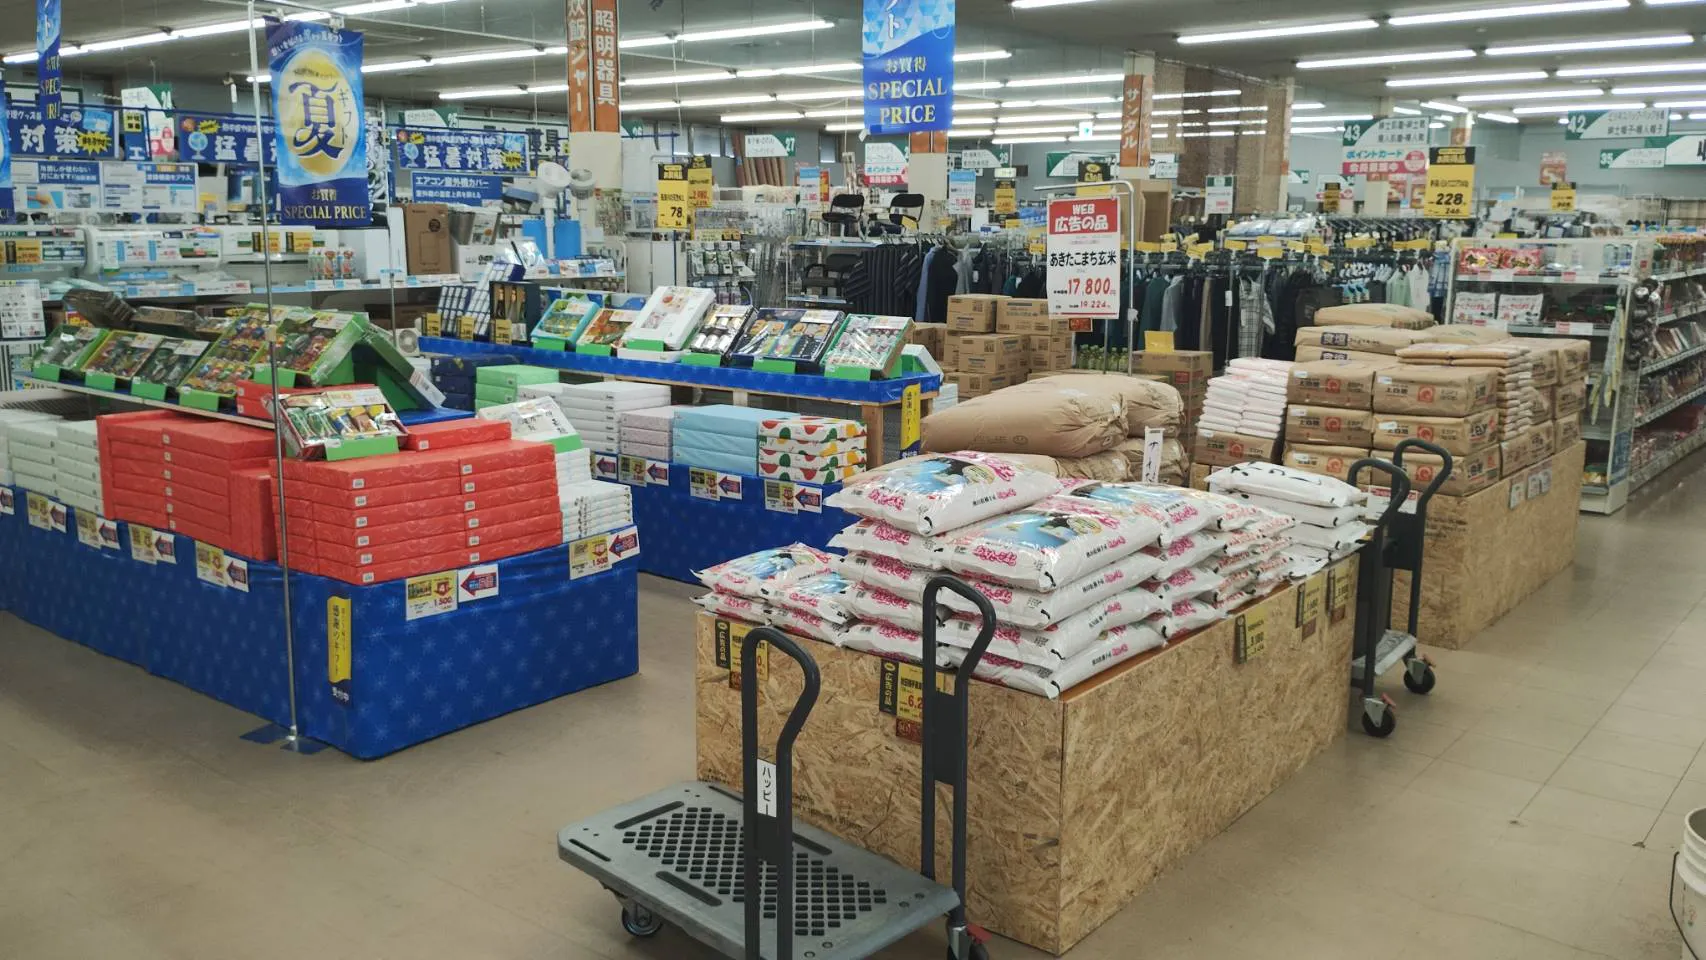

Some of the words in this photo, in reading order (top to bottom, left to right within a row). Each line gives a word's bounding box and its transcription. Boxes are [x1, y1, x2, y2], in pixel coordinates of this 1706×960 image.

[594, 9, 617, 106] 照明器具
[885, 56, 926, 73] お買得
[867, 78, 947, 100] SPECIAL
[289, 80, 344, 160] 夏
[337, 88, 353, 146] ギフト
[880, 104, 936, 125] PRICE
[1567, 114, 1587, 133] 42
[1344, 125, 1361, 141] 43
[1346, 150, 1403, 160] ポイントカード
[311, 187, 337, 201] お買得
[1436, 193, 1464, 205] 228
[284, 204, 331, 220] SPECIAL
[333, 204, 367, 219] PRICE
[670, 207, 683, 218] 78
[1072, 203, 1096, 215] WEB
[1055, 215, 1109, 233] 広告の品
[1050, 250, 1117, 267] あきたこまち玄米
